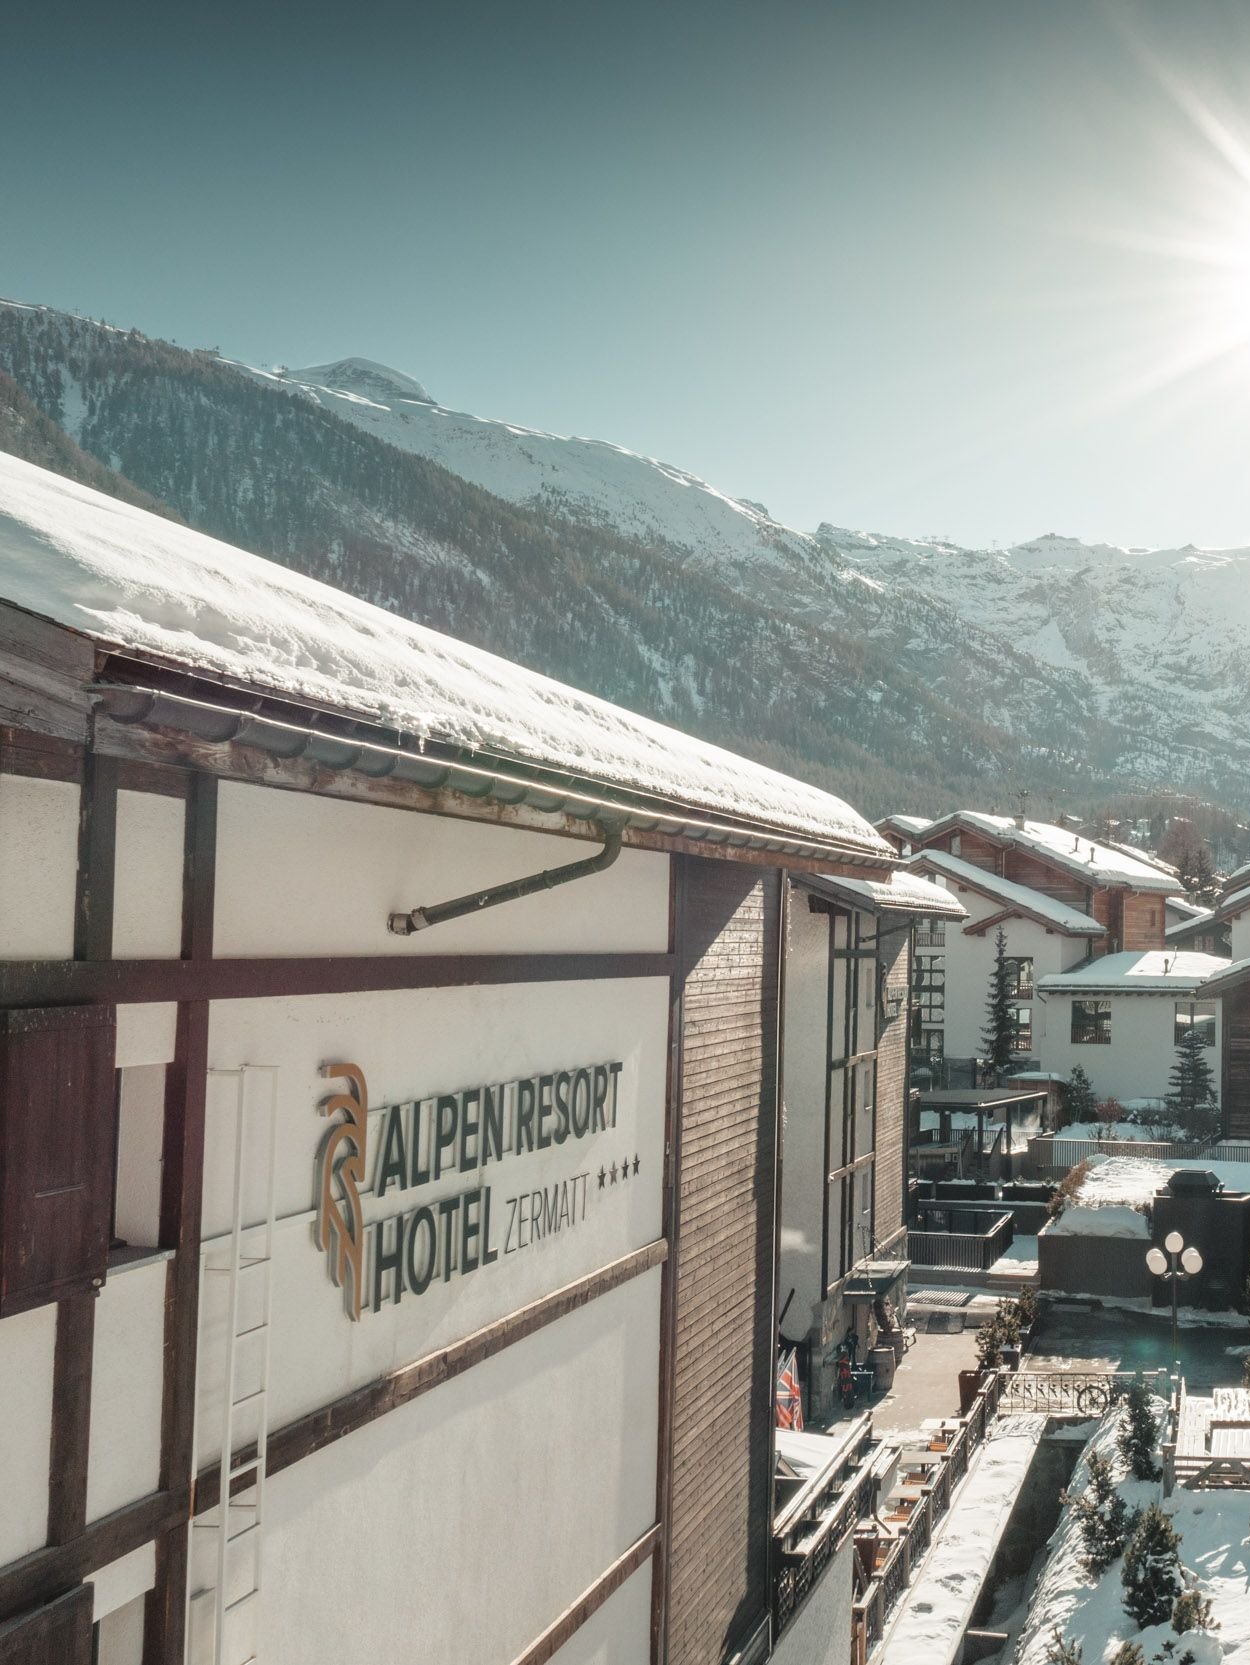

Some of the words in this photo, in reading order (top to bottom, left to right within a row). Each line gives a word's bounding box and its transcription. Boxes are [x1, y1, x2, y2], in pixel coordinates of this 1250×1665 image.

[376, 1084, 505, 1198] ALPEN
[516, 1062, 623, 1156] RESORT
[373, 1186, 498, 1313] HOTEL
[504, 1172, 590, 1254] ZERMATT
